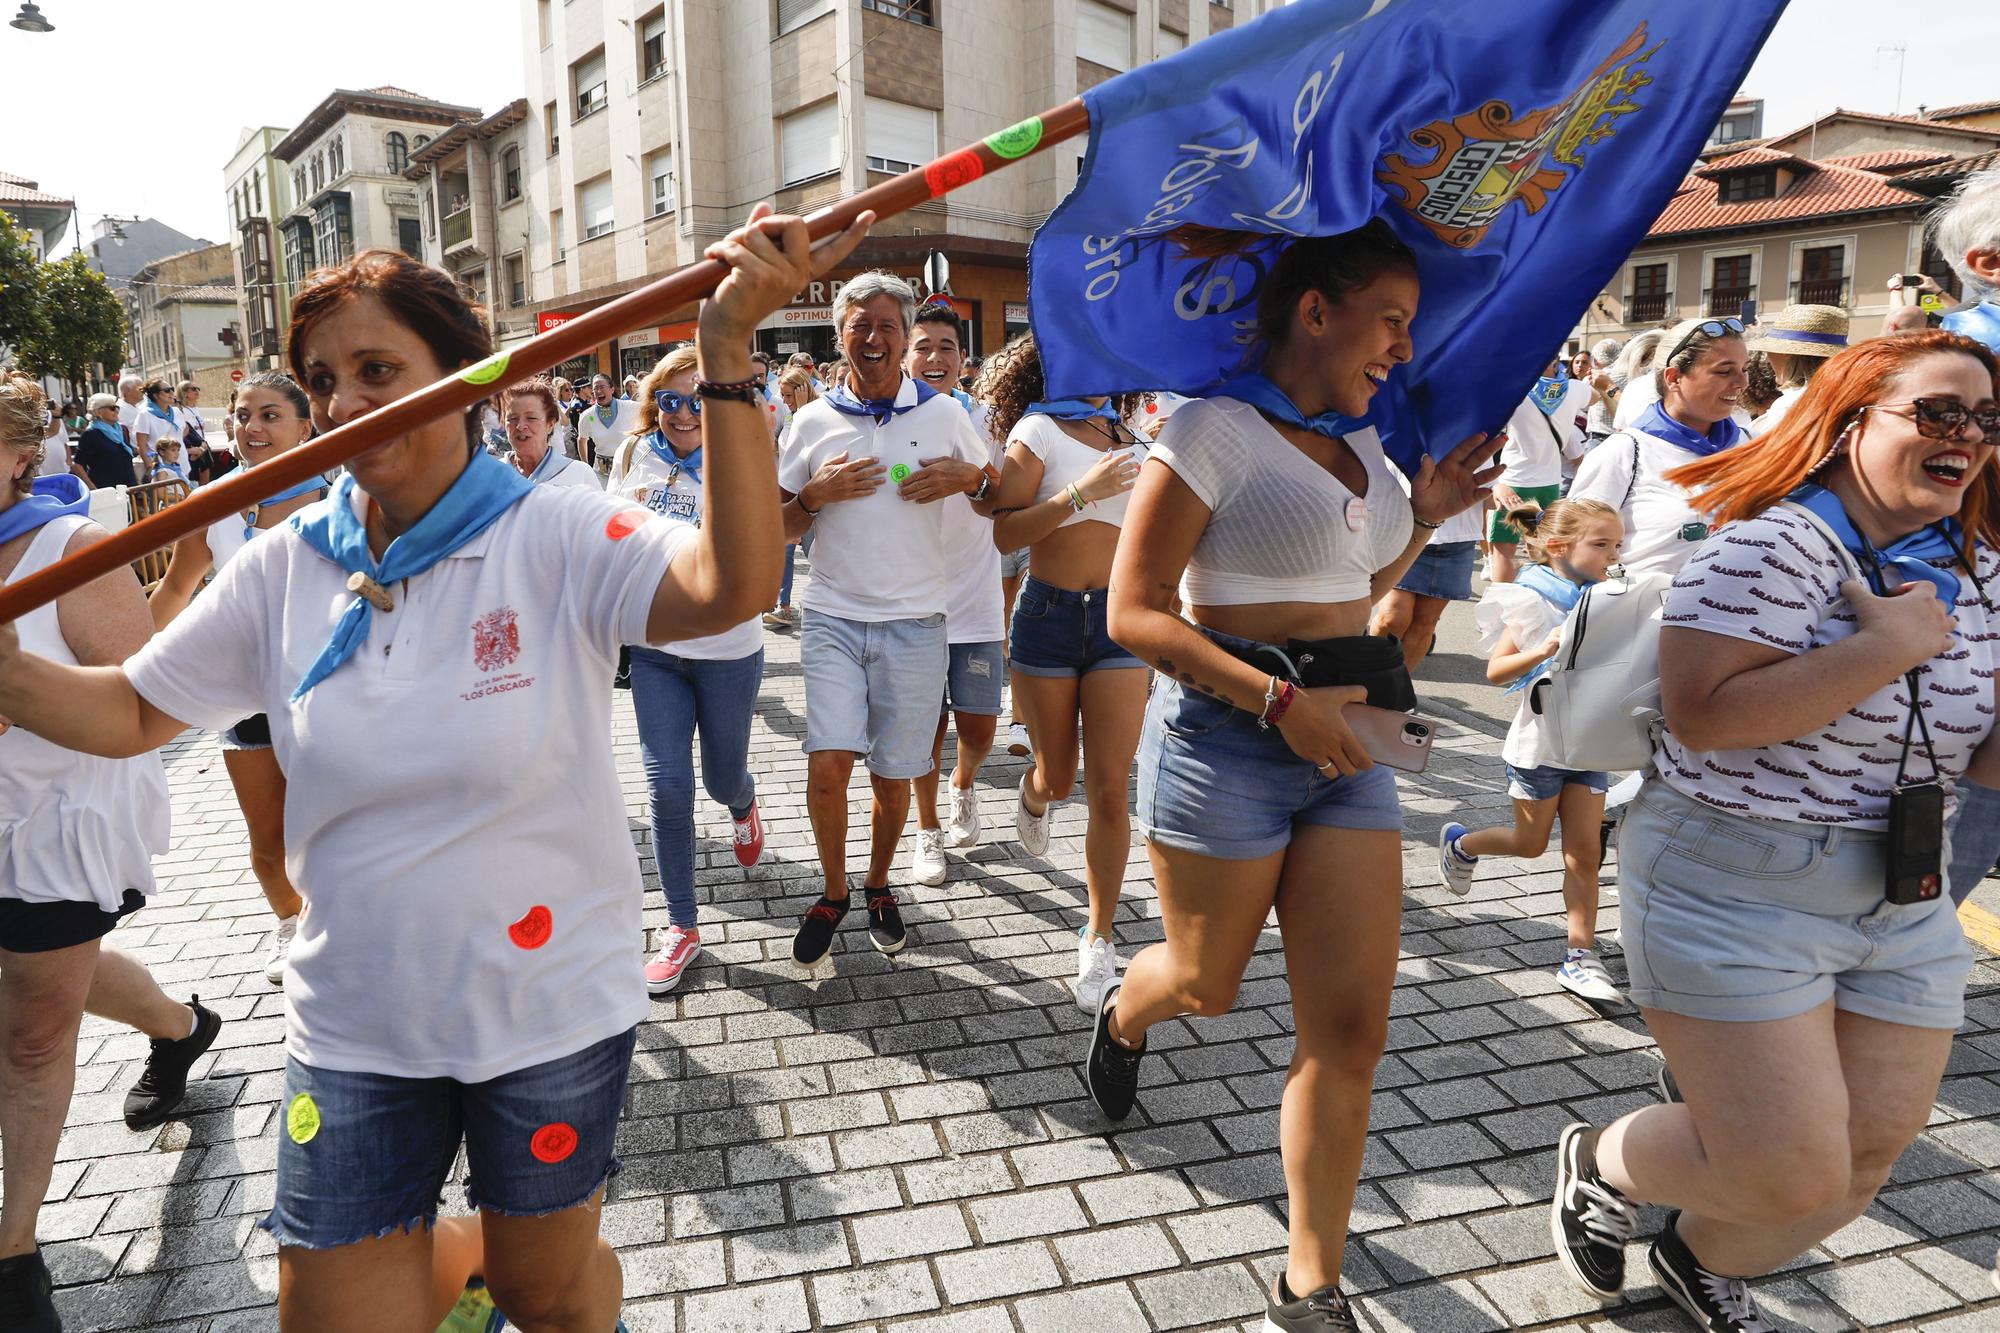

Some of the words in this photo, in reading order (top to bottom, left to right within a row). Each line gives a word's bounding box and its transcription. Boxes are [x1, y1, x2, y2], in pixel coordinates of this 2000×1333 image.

[627, 333, 649, 344] OPTIMUS
[1708, 564, 1763, 579] DRAMATIC
[1699, 597, 1759, 615] DRAMATIC
[1748, 587, 1807, 610] DRAMATIC
[1749, 626, 1804, 648] DRAMATIC
[1929, 682, 1979, 696] DRAMATIC
[1933, 720, 1982, 734] DRAMATIC
[1704, 759, 1755, 779] DRAMATIC
[1754, 758, 1809, 779] DRAMATIC
[1807, 760, 1863, 777] DRAMATIC
[1694, 791, 1749, 810] DRAMATIC
[1800, 786, 1858, 807] DRAMATIC
